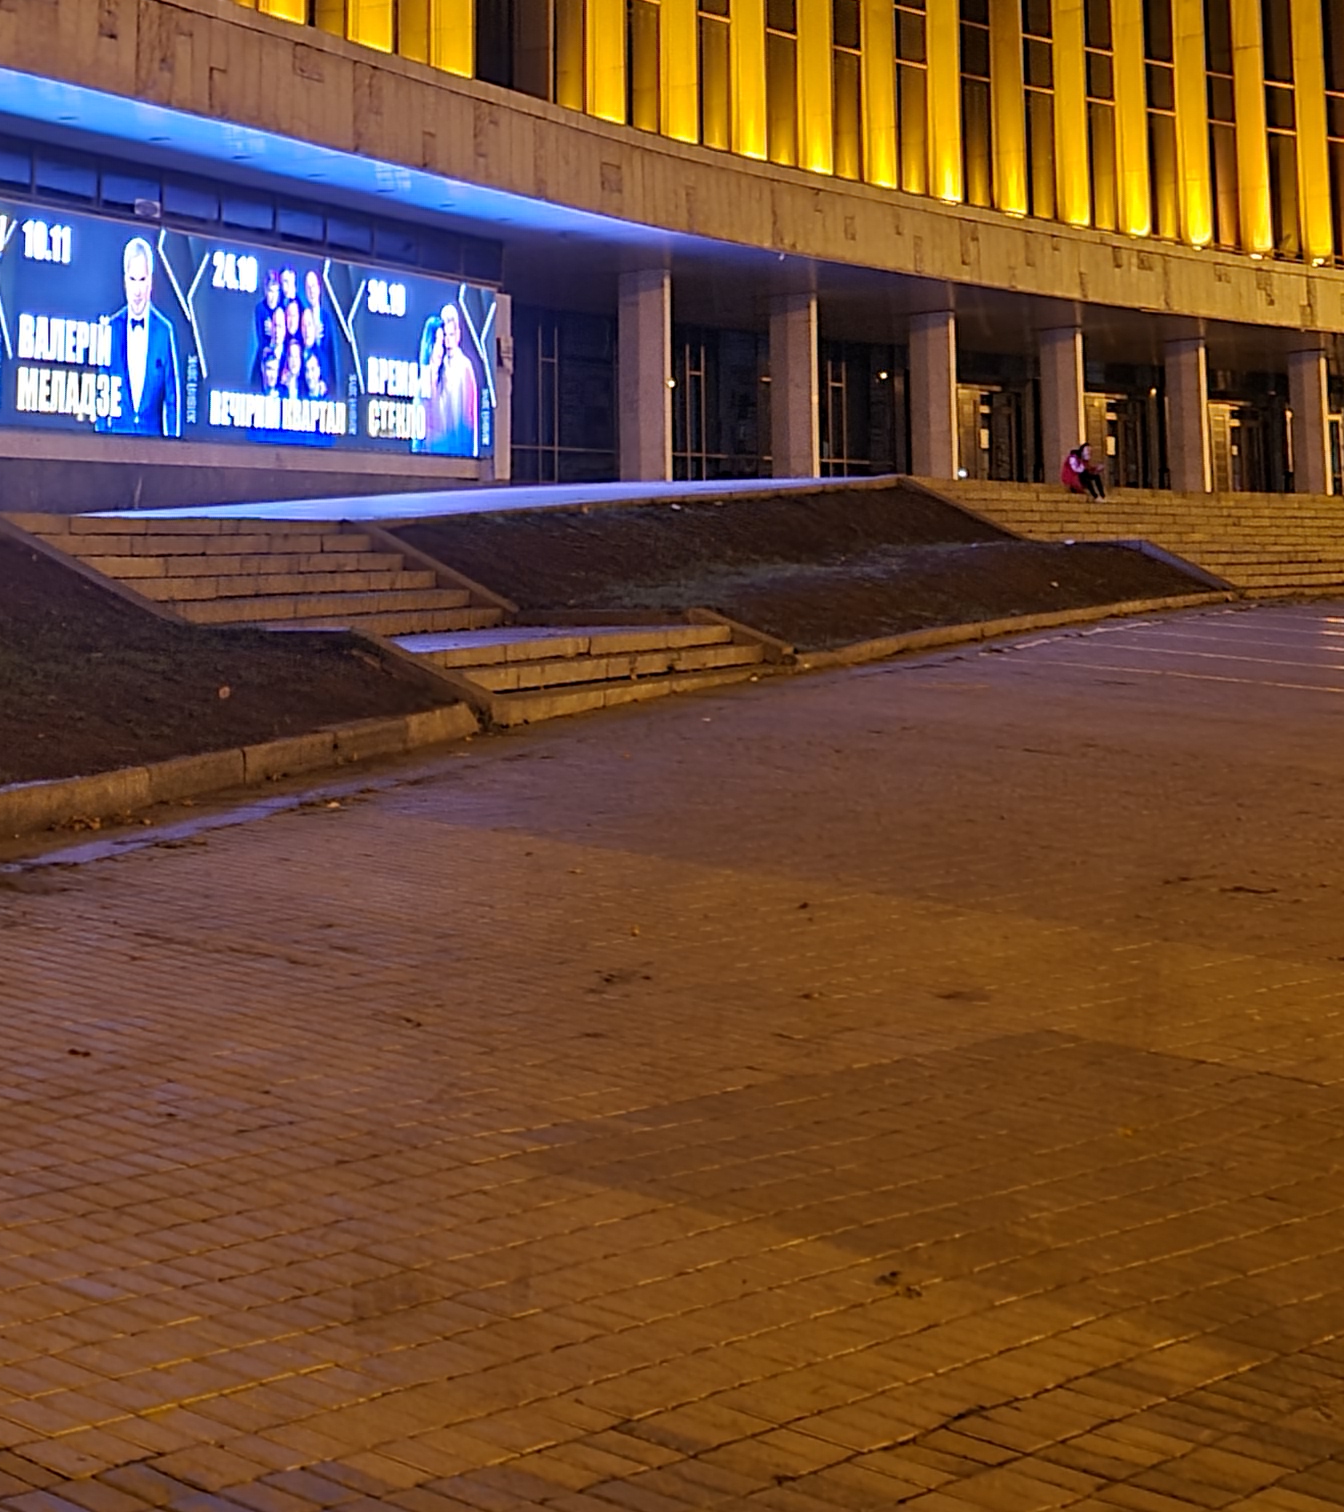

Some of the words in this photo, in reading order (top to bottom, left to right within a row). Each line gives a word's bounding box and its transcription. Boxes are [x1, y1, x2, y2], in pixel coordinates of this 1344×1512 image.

[22, 219, 72, 264] 10.11
[18, 313, 112, 366] ВАЛЕРІЙ
[17, 366, 122, 422] МЕЛАДЗЕ
[283, 399, 346, 434] КВАРТАЛ
[369, 400, 426, 439] СТЕКЛО
